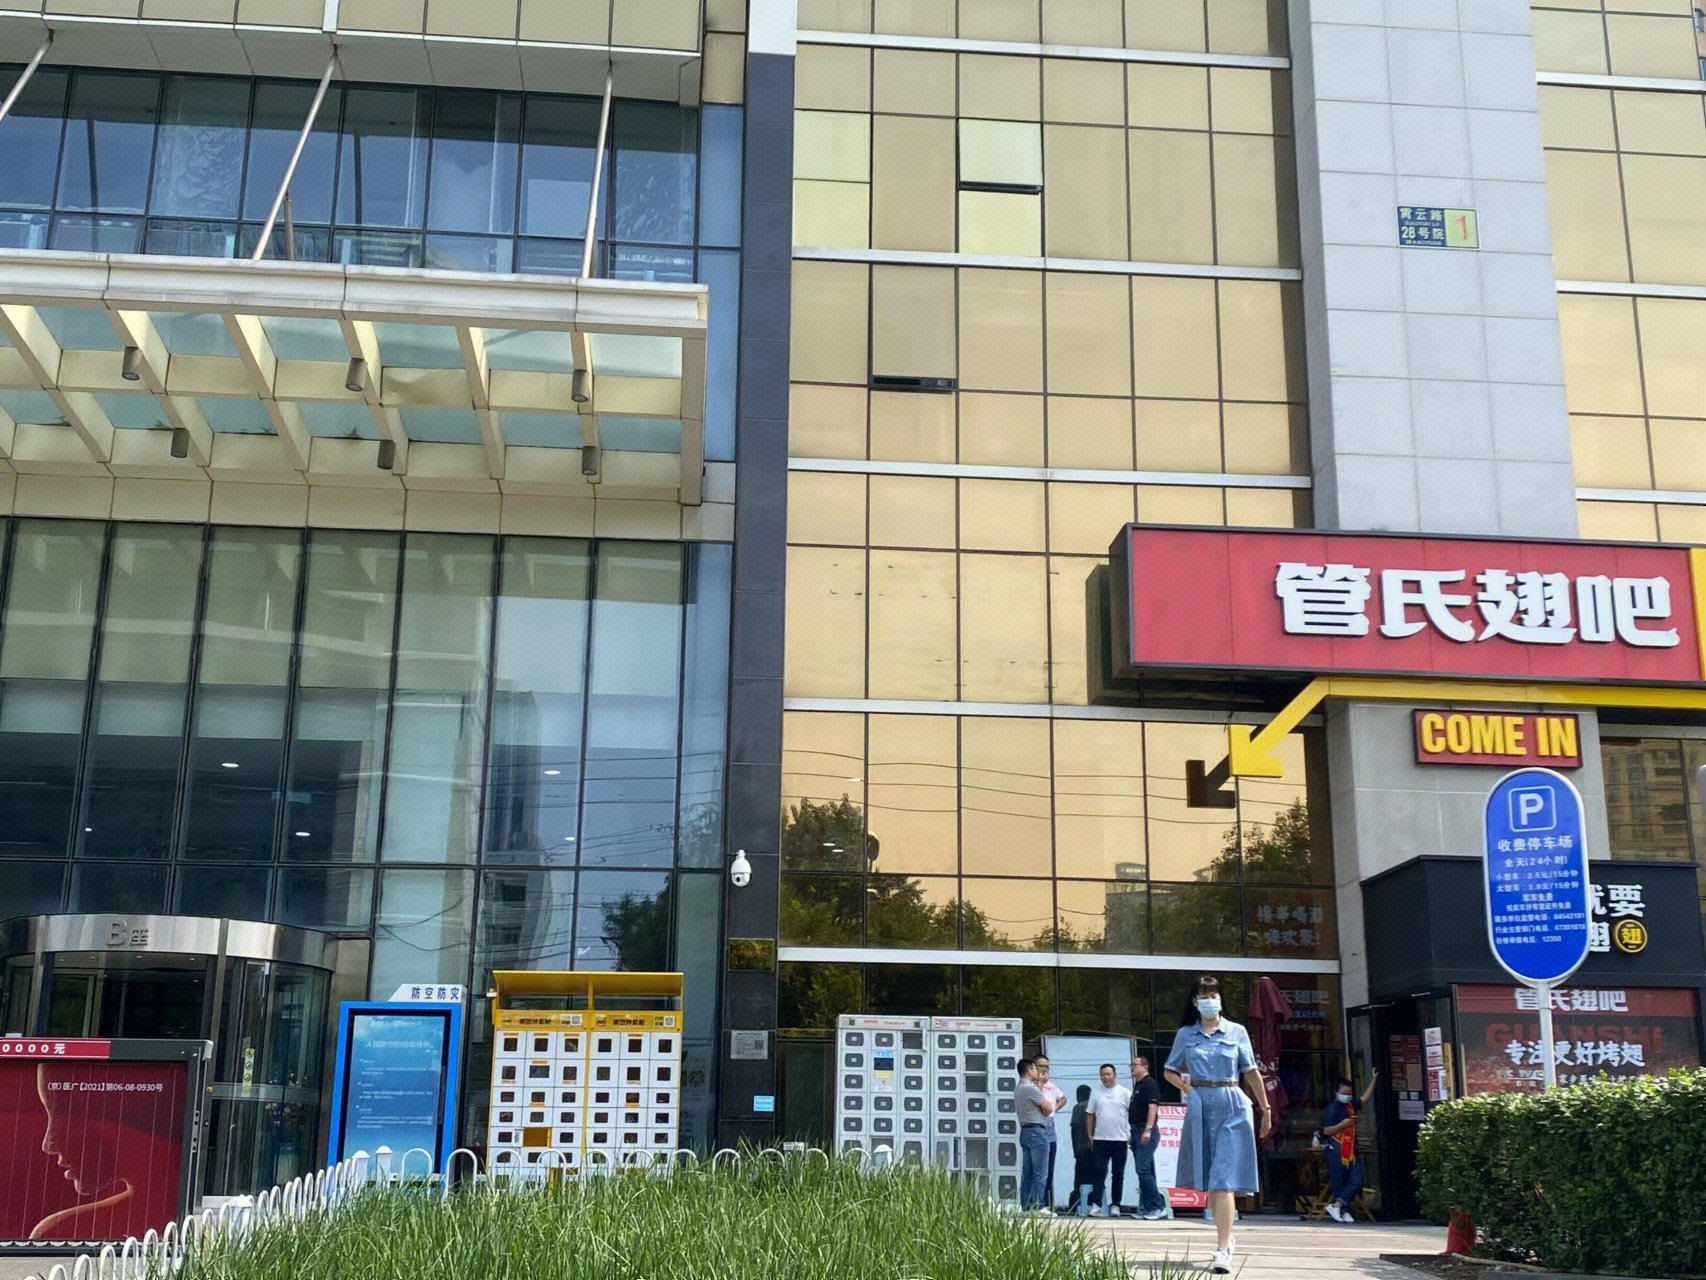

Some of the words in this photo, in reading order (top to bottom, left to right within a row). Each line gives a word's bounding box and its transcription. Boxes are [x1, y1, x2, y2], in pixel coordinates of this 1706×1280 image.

[1401, 226, 1445, 240] 28号院
[1456, 215, 1467, 240] 1
[1276, 561, 1680, 648] 管氏翅吧
[1420, 711, 1527, 757] COME
[1537, 714, 1578, 758] IN
[1519, 792, 1544, 826] P
[1497, 835, 1573, 853] 收费停车场
[1620, 927, 1643, 945] 翅
[411, 986, 460, 1001] 防空防灾
